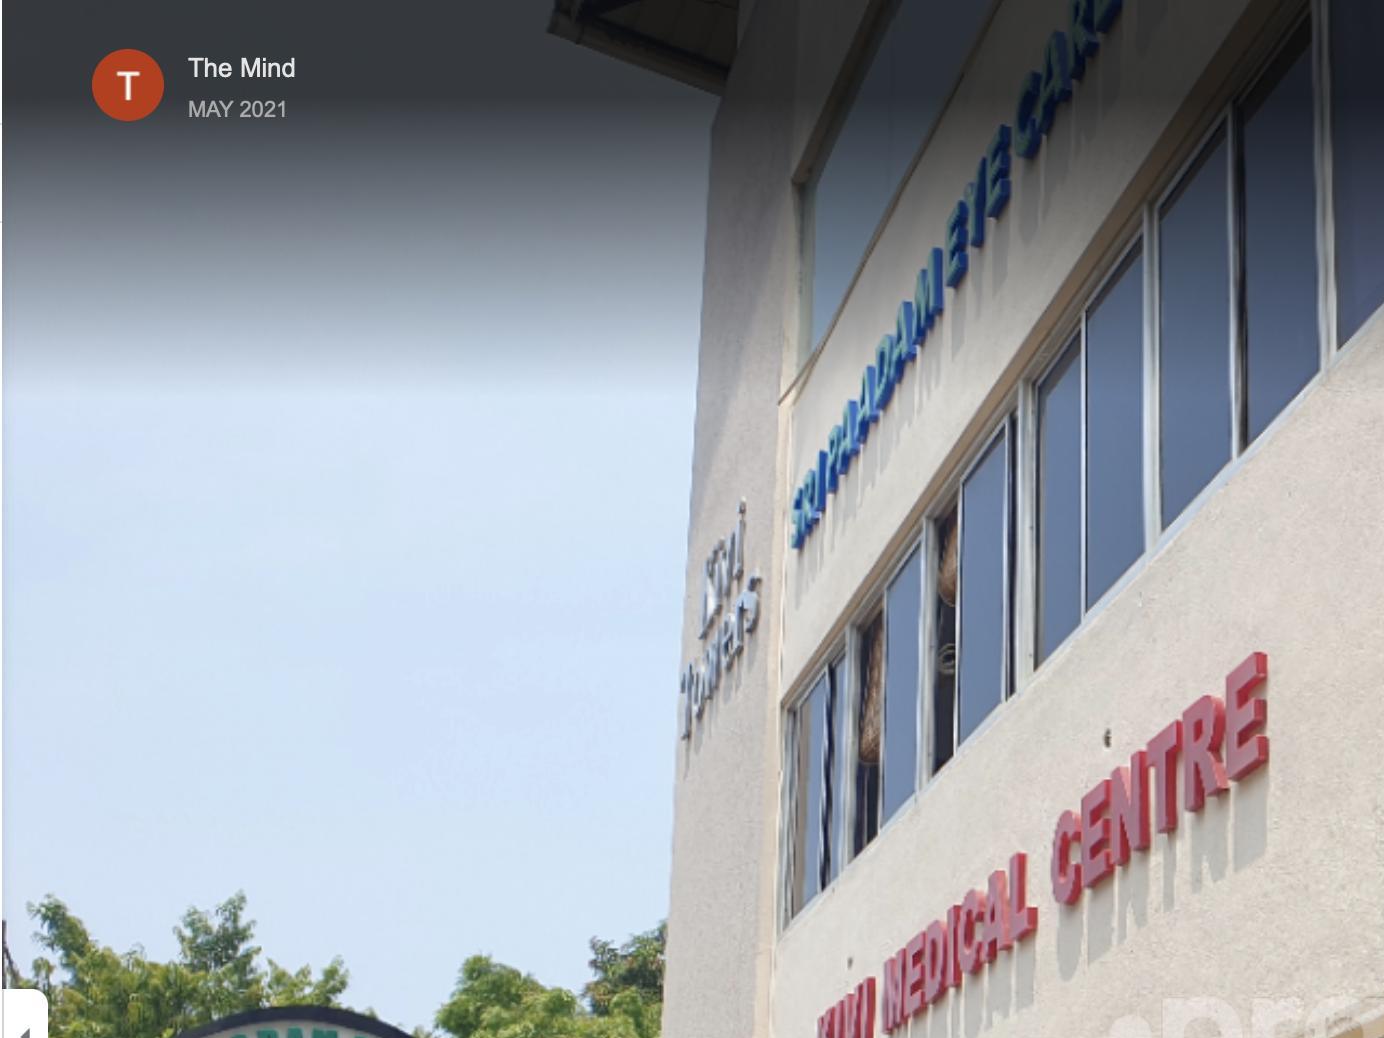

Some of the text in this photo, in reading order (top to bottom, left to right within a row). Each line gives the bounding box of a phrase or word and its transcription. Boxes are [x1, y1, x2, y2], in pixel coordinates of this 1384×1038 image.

[791, 449, 827, 549] SRI
[827, 247, 943, 493] PAADAM
[946, 124, 1012, 287] EYE
[882, 852, 1038, 1036] MEDICAL
[1051, 651, 1270, 905] CENTRE
